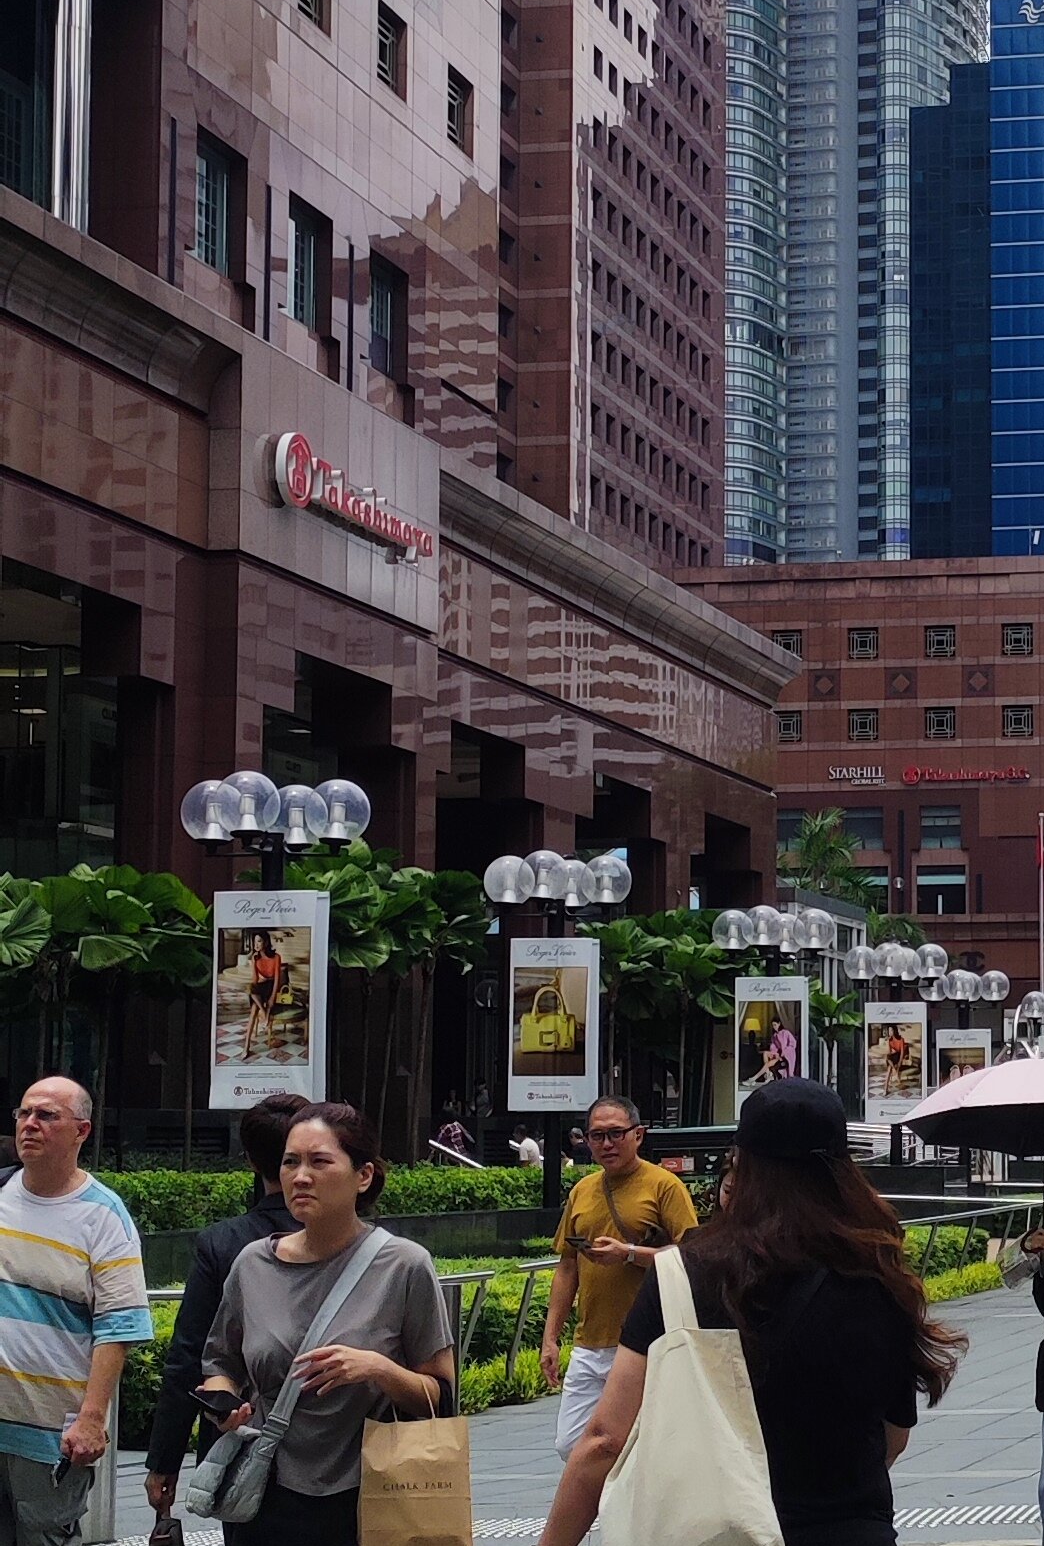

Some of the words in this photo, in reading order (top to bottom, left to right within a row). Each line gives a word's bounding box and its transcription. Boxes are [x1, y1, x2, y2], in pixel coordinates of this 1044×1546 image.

[311, 457, 433, 565] Takashimaya
[828, 765, 885, 780] STARHILL
[233, 899, 266, 920] Roger
[265, 898, 296, 913] Vivier
[383, 1482, 418, 1491] CHALK
